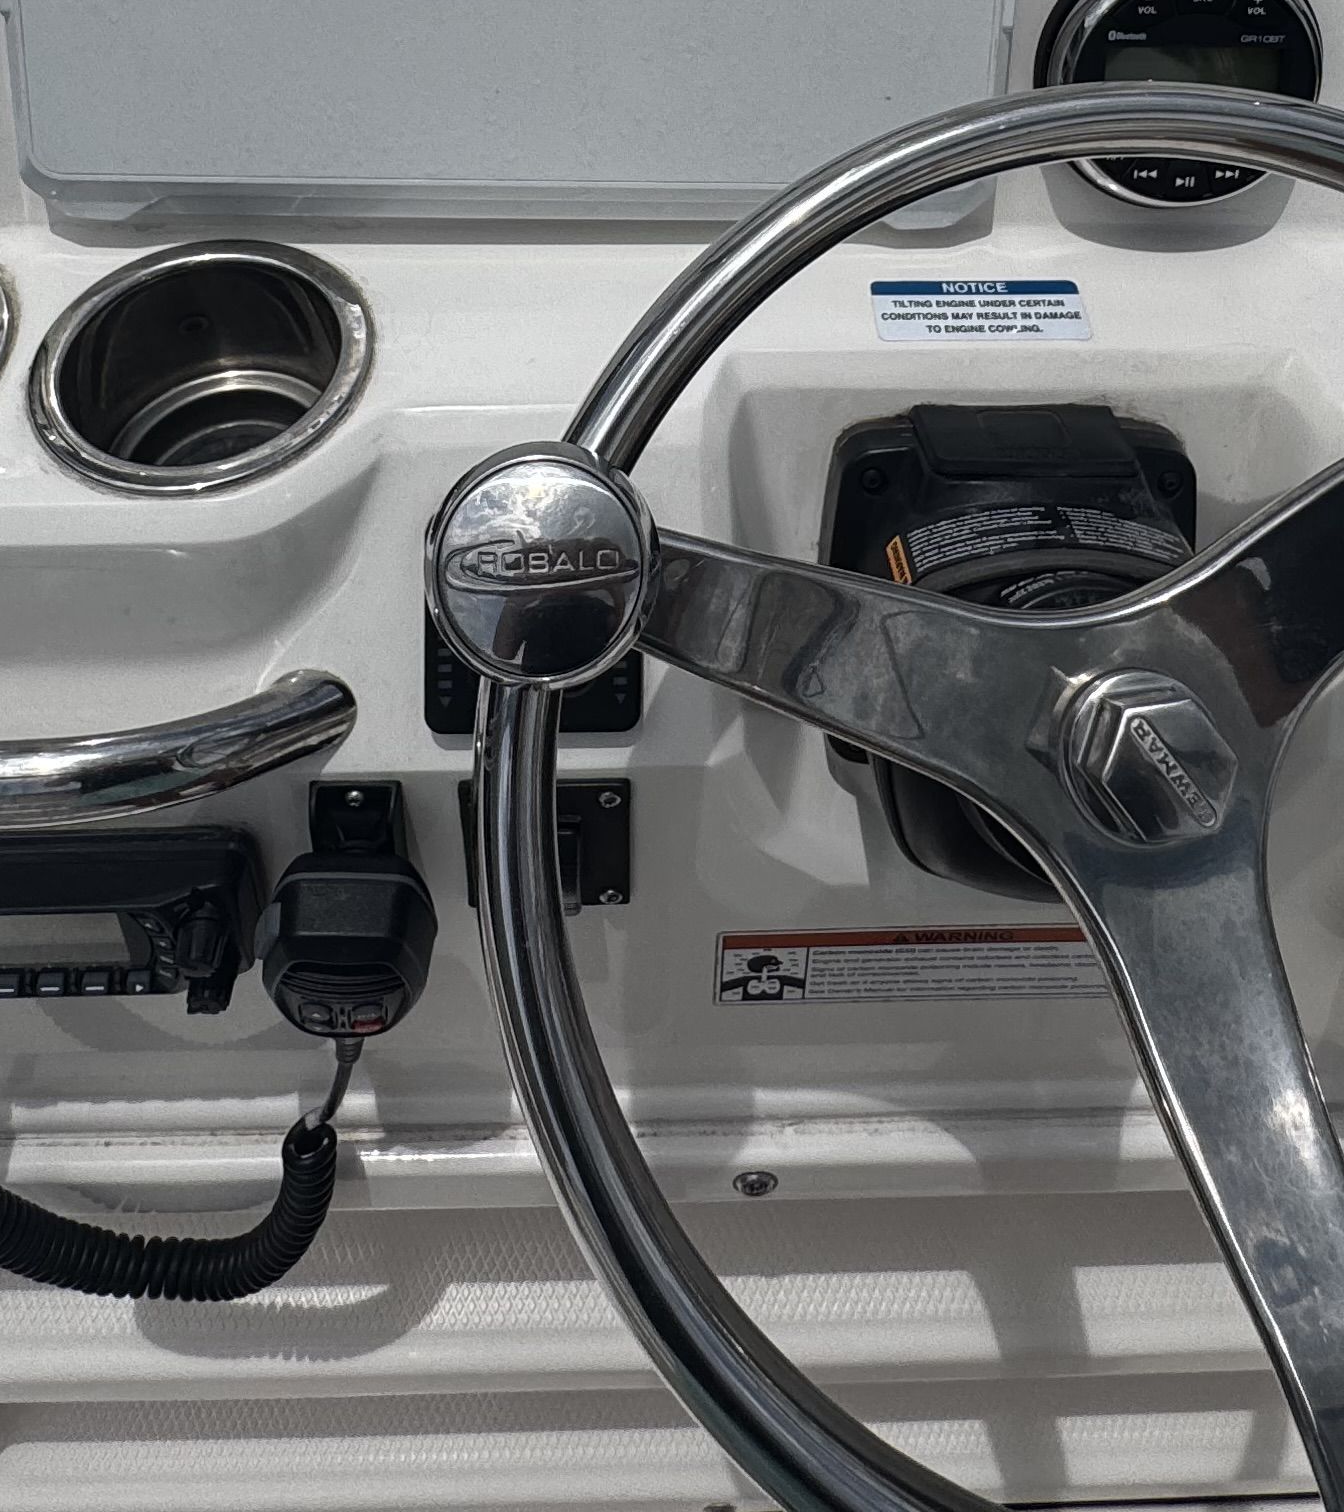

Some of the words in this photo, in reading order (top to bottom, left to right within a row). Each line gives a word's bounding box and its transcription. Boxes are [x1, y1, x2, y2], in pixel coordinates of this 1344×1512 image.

[1138, 6, 1157, 15] VOL
[1247, 6, 1266, 16] VOL
[941, 282, 1009, 293] NOTICE
[892, 300, 933, 308] TILTING
[935, 299, 976, 308] ENGINE
[978, 299, 1016, 308] UNDER
[1018, 299, 1065, 307] CERTAIN
[881, 312, 949, 321] CONDITIONS
[951, 312, 974, 320] MAY
[976, 311, 1018, 320] RESULT
[1020, 311, 1033, 320] IN
[1034, 311, 1082, 320] DAMAGE
[926, 325, 942, 333] TO
[944, 324, 986, 333] ENGINE
[476, 549, 620, 576] ROBALO
[1132, 720, 1204, 810] EWMAR
[915, 930, 1014, 942] WARNING
